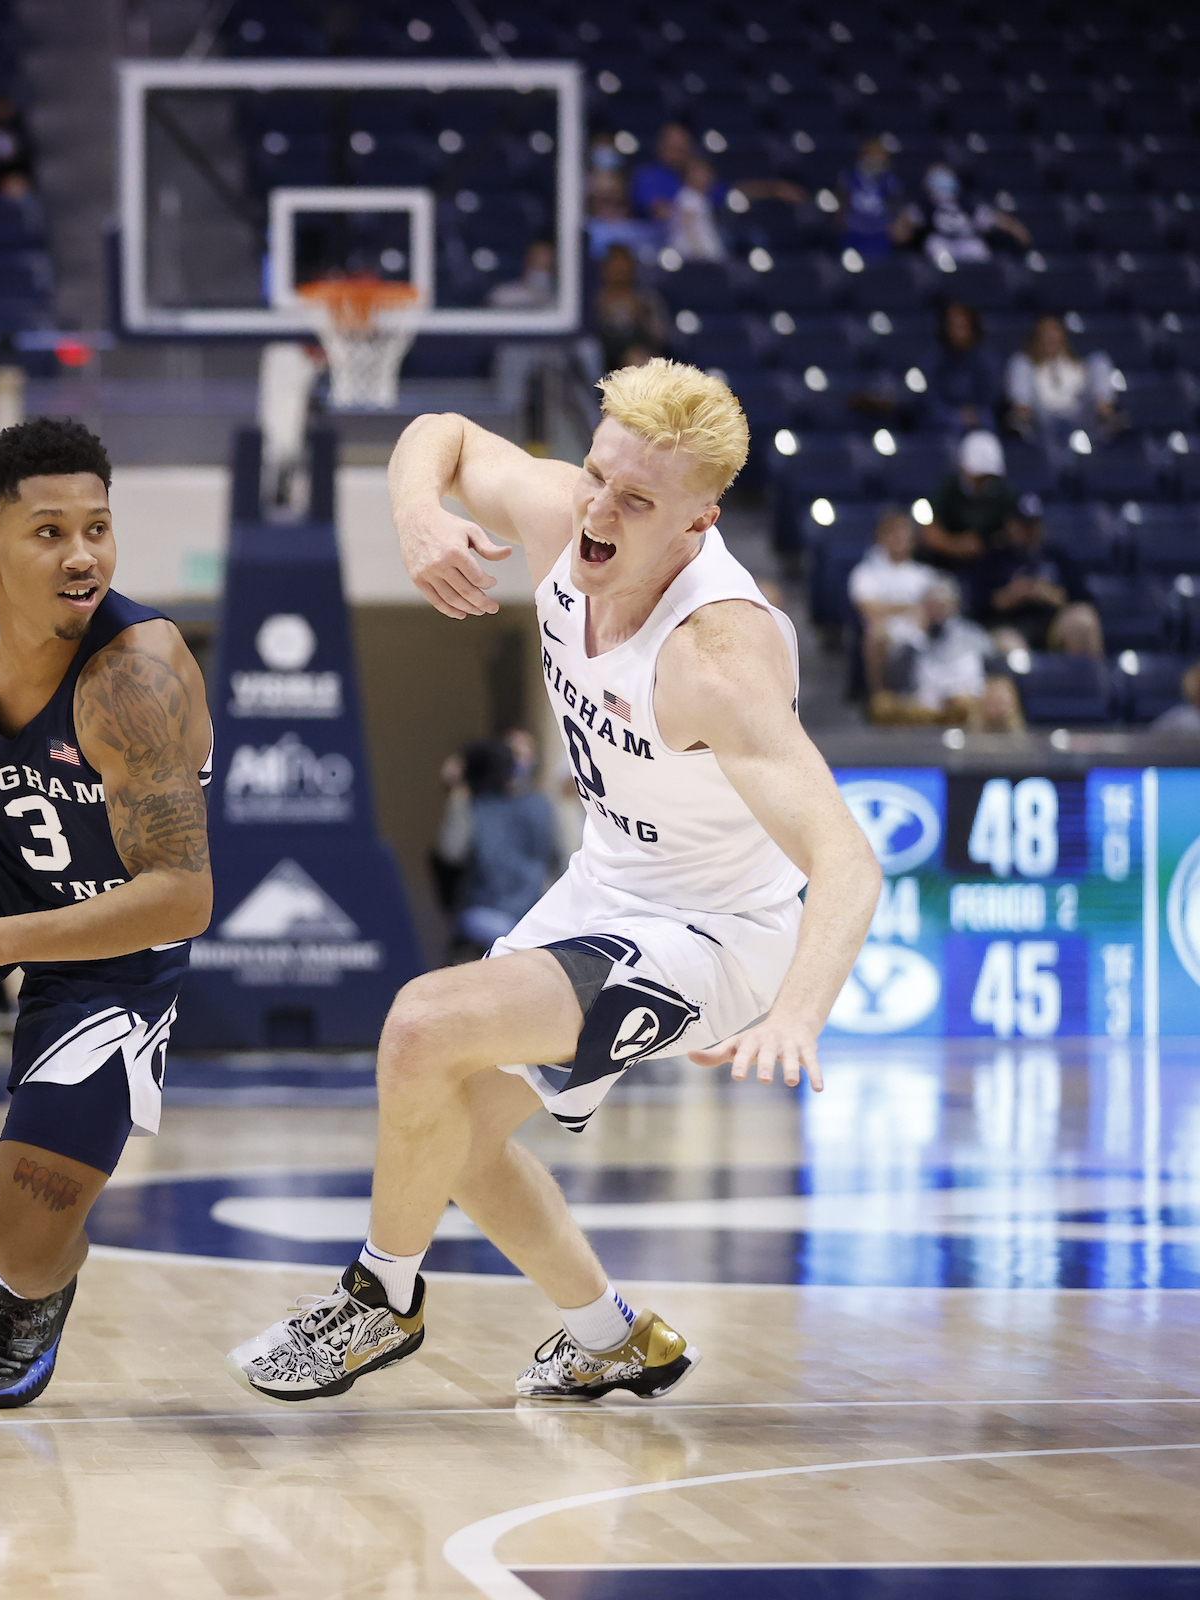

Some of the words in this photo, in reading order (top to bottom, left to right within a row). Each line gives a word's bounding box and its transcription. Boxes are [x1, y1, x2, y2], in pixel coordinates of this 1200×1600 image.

[562, 714, 606, 798] 0
[3, 794, 73, 872] 3
[968, 777, 1059, 878] 48
[971, 941, 1062, 1039] 45
